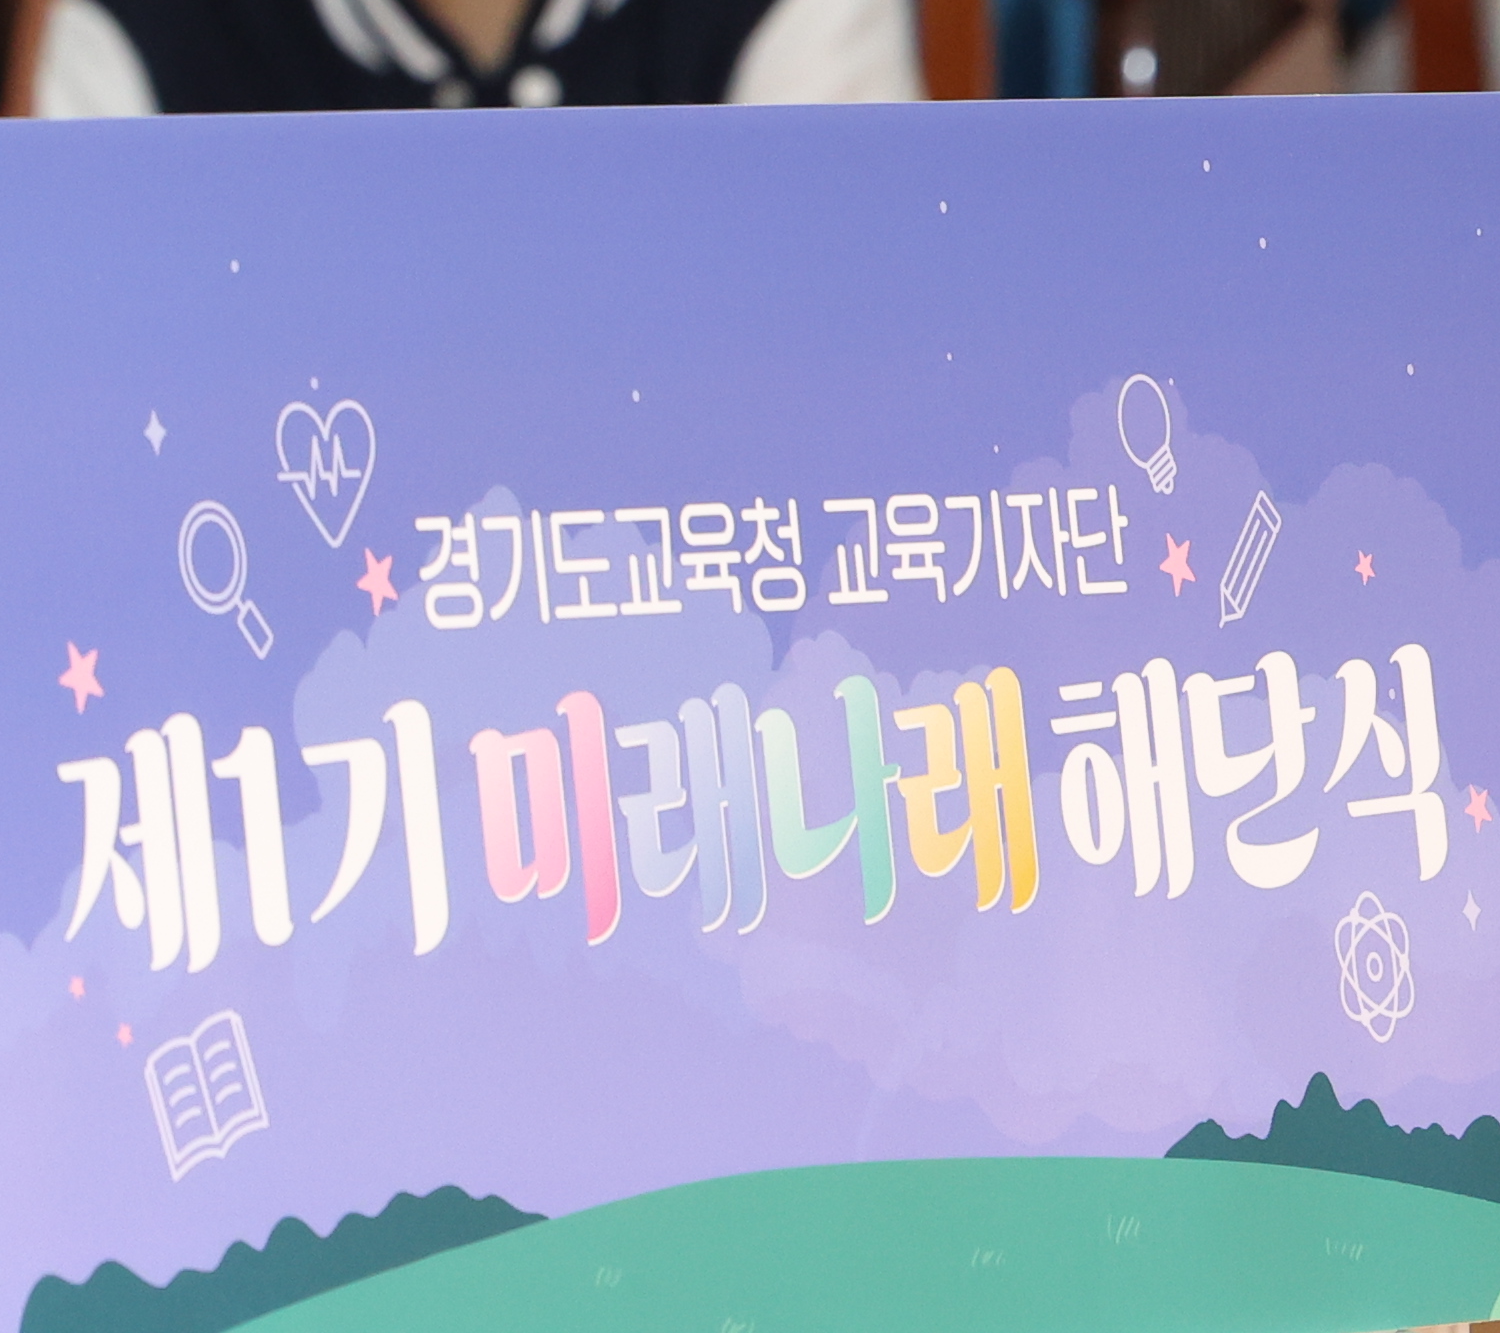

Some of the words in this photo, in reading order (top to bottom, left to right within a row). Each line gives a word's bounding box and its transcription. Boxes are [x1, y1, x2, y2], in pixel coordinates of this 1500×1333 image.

[414, 496, 807, 630] 경기도교육청
[822, 484, 1130, 606] 교육기자단
[56, 698, 451, 974] 제1기
[468, 665, 1040, 947] 미래나래
[1049, 642, 1450, 900] 해단식
